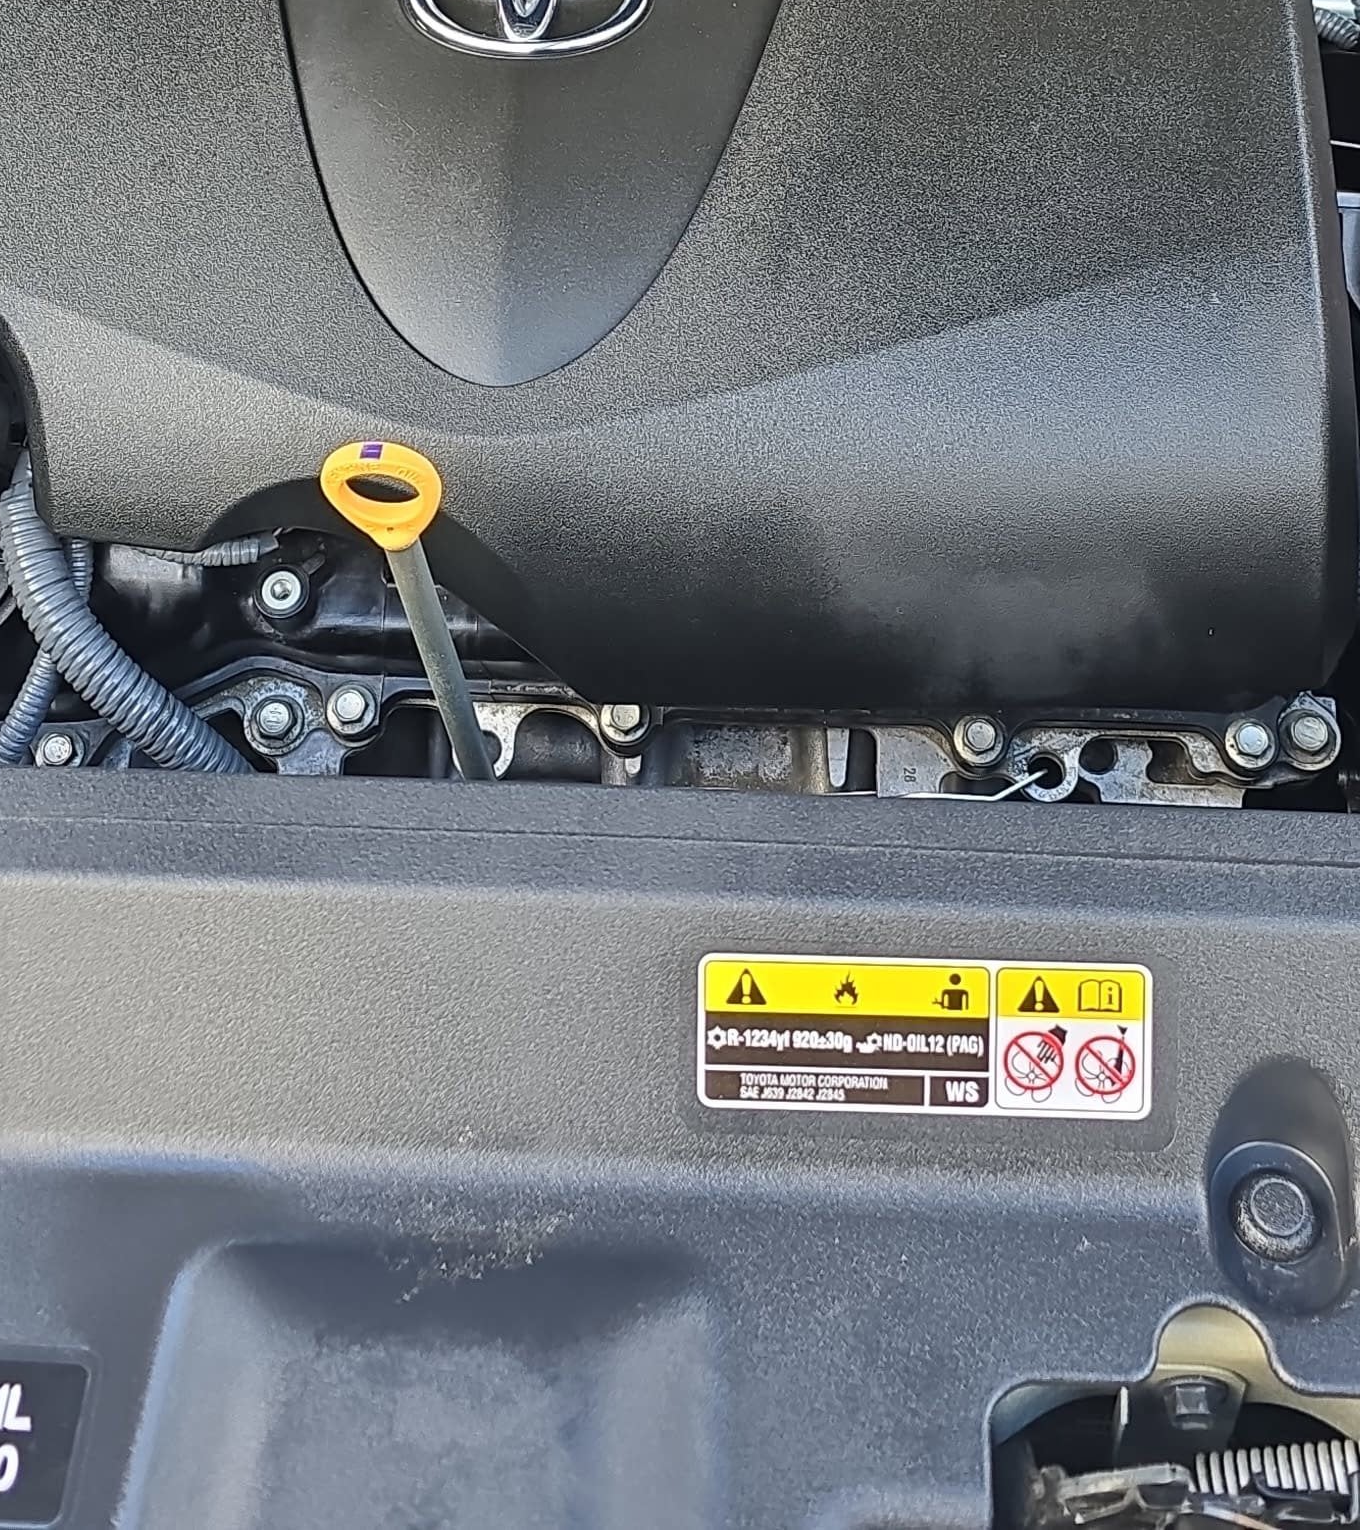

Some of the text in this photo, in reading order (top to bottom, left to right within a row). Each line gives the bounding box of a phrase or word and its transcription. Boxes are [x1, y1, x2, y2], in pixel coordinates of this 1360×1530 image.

[903, 767, 917, 783] 28
[727, 1029, 791, 1050] R-1234yf
[792, 1030, 853, 1053] 920±30g
[946, 1034, 984, 1057] (PAG)
[739, 1073, 889, 1089] TOYOTA MOTOR CORPORATION
[739, 1087, 759, 1099] SAE
[945, 1080, 980, 1103] WS
